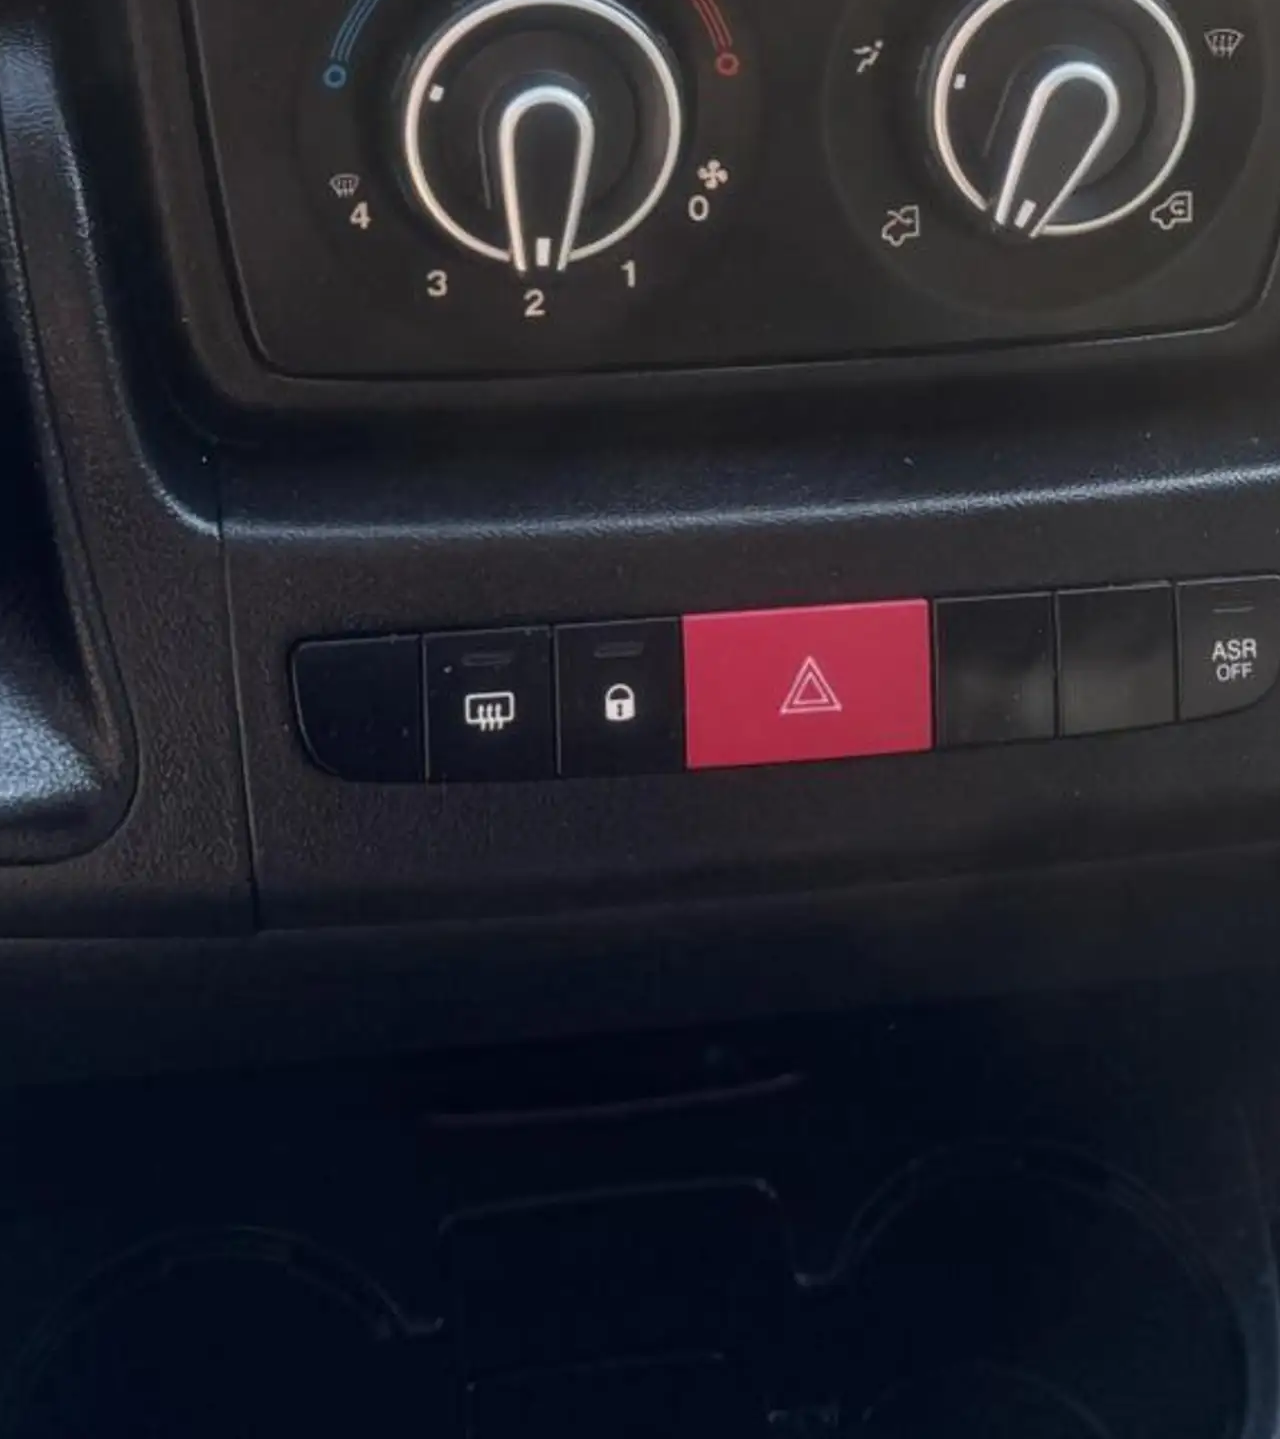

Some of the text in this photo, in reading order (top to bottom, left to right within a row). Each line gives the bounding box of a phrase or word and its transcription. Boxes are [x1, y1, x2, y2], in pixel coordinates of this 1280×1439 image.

[349, 199, 373, 230] 4
[687, 197, 710, 222] 0
[426, 269, 449, 298] 3
[621, 260, 637, 288] 1
[523, 289, 546, 317] 2
[1212, 638, 1257, 662] ASR
[1215, 663, 1254, 683] OFF
